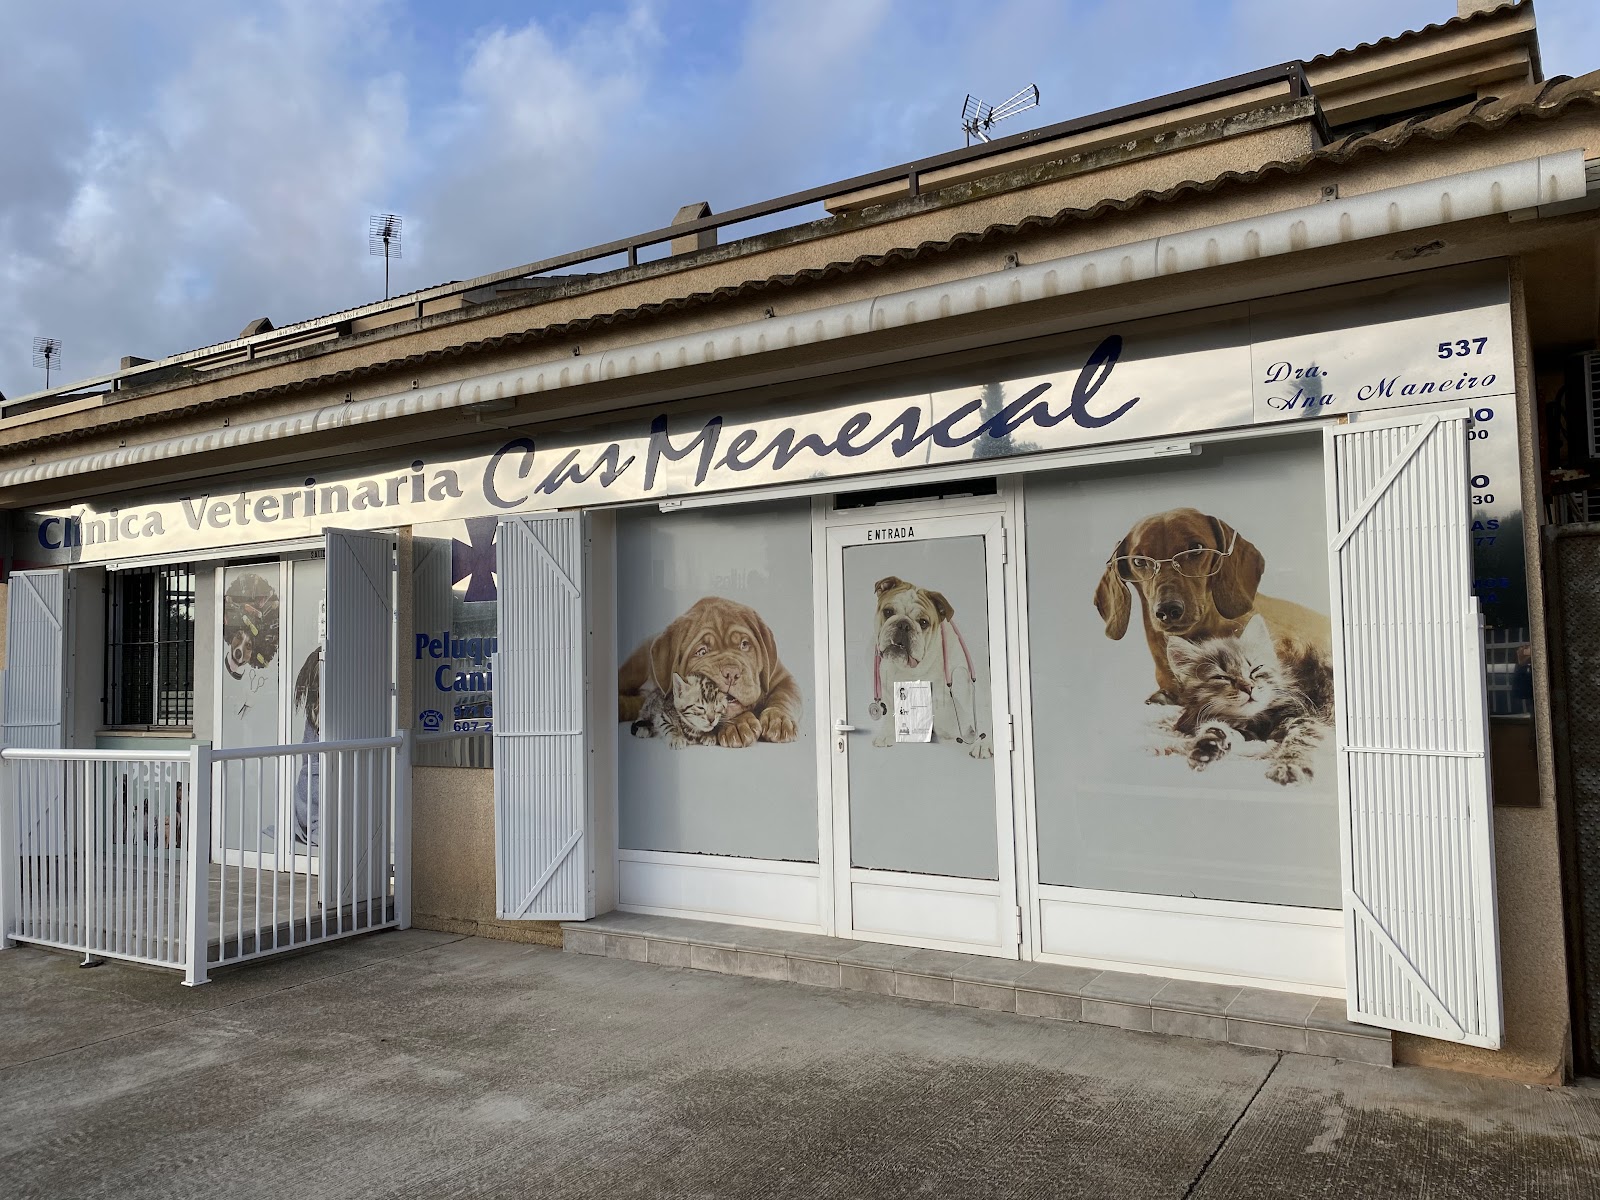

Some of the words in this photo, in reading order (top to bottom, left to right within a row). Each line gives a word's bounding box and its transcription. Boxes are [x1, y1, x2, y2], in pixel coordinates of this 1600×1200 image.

[1438, 337, 1488, 359] 537
[1264, 361, 1328, 384] Dra.
[1267, 388, 1337, 411] Ana
[1357, 372, 1496, 401] Maneiro
[38, 508, 165, 549] Clínica
[180, 459, 464, 530] Veterinaria
[482, 437, 635, 509] Cas
[644, 334, 1140, 491] Menescal
[867, 526, 915, 541] ENTRADA
